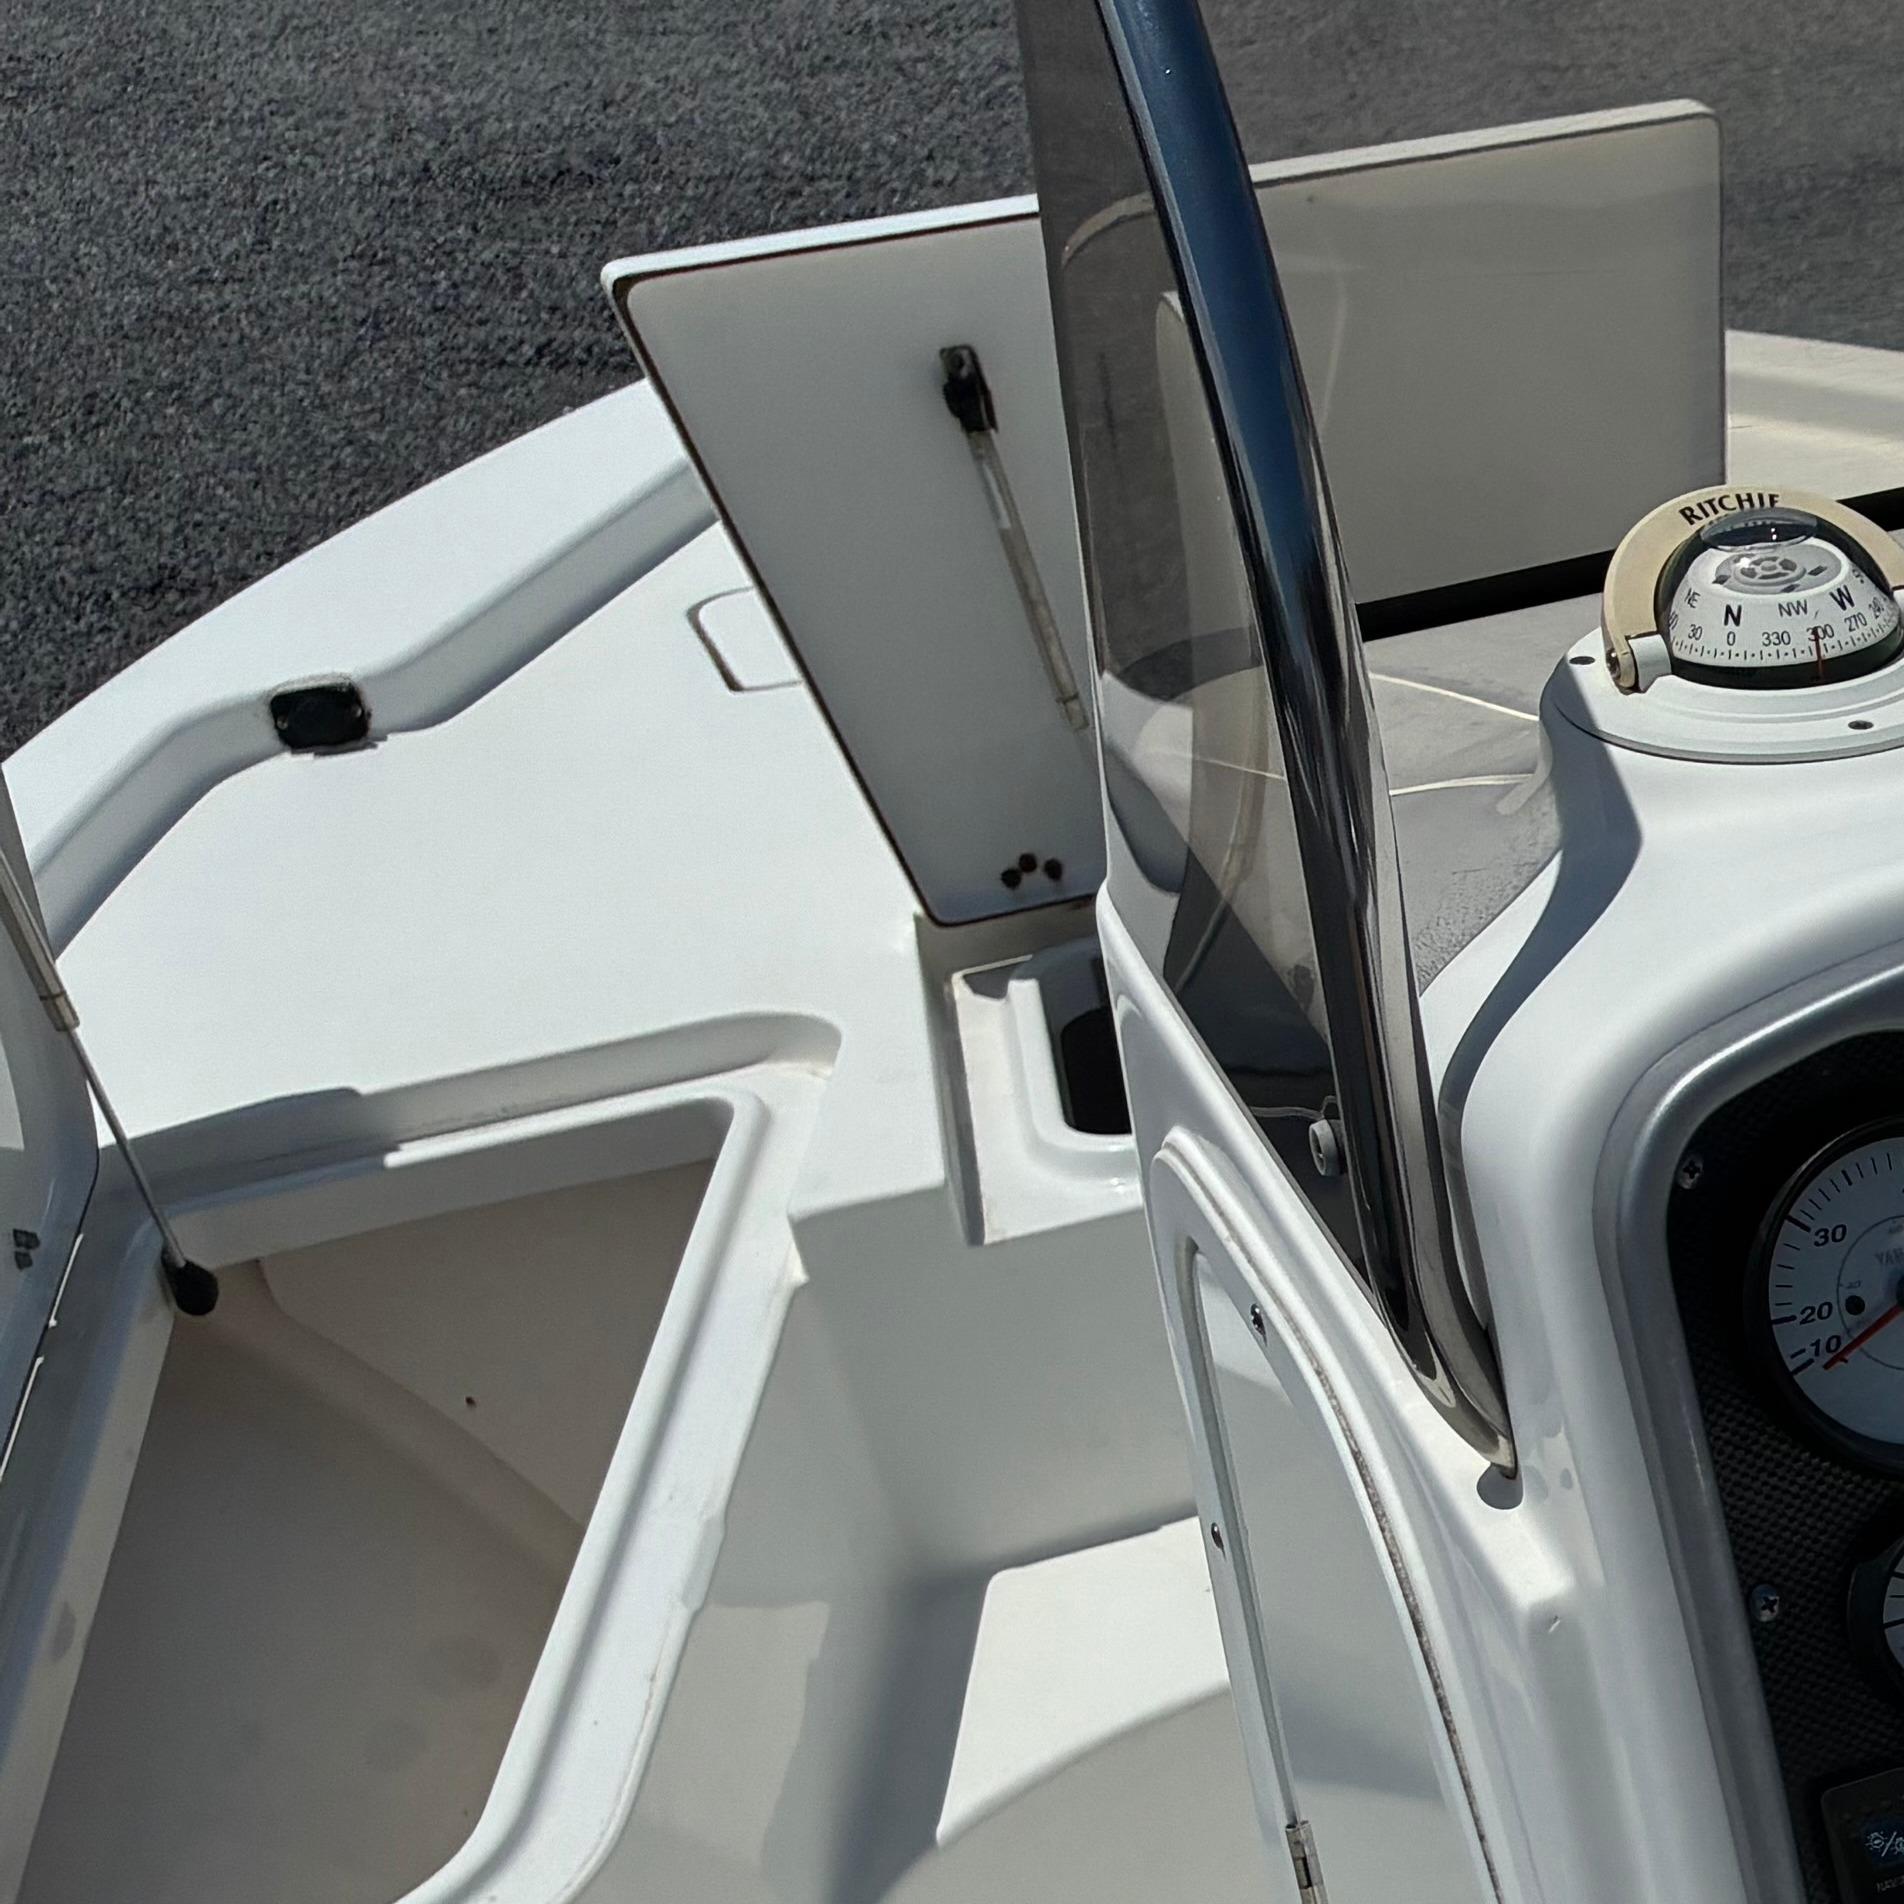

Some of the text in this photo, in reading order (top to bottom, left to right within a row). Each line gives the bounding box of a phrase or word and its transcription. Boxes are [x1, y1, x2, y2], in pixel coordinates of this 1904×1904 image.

[1830, 585, 1855, 611] W
[1723, 604, 1742, 627] N
[1778, 600, 1808, 617] NW
[1687, 624, 1702, 640] 30
[1844, 612, 1867, 632] 270
[1727, 631, 1736, 646] 0
[1762, 631, 1791, 646] 330
[1806, 624, 1834, 641] 300
[1814, 1224, 1847, 1248] 30
[1799, 1300, 1833, 1325] 20
[1809, 1335, 1842, 1358] 10
